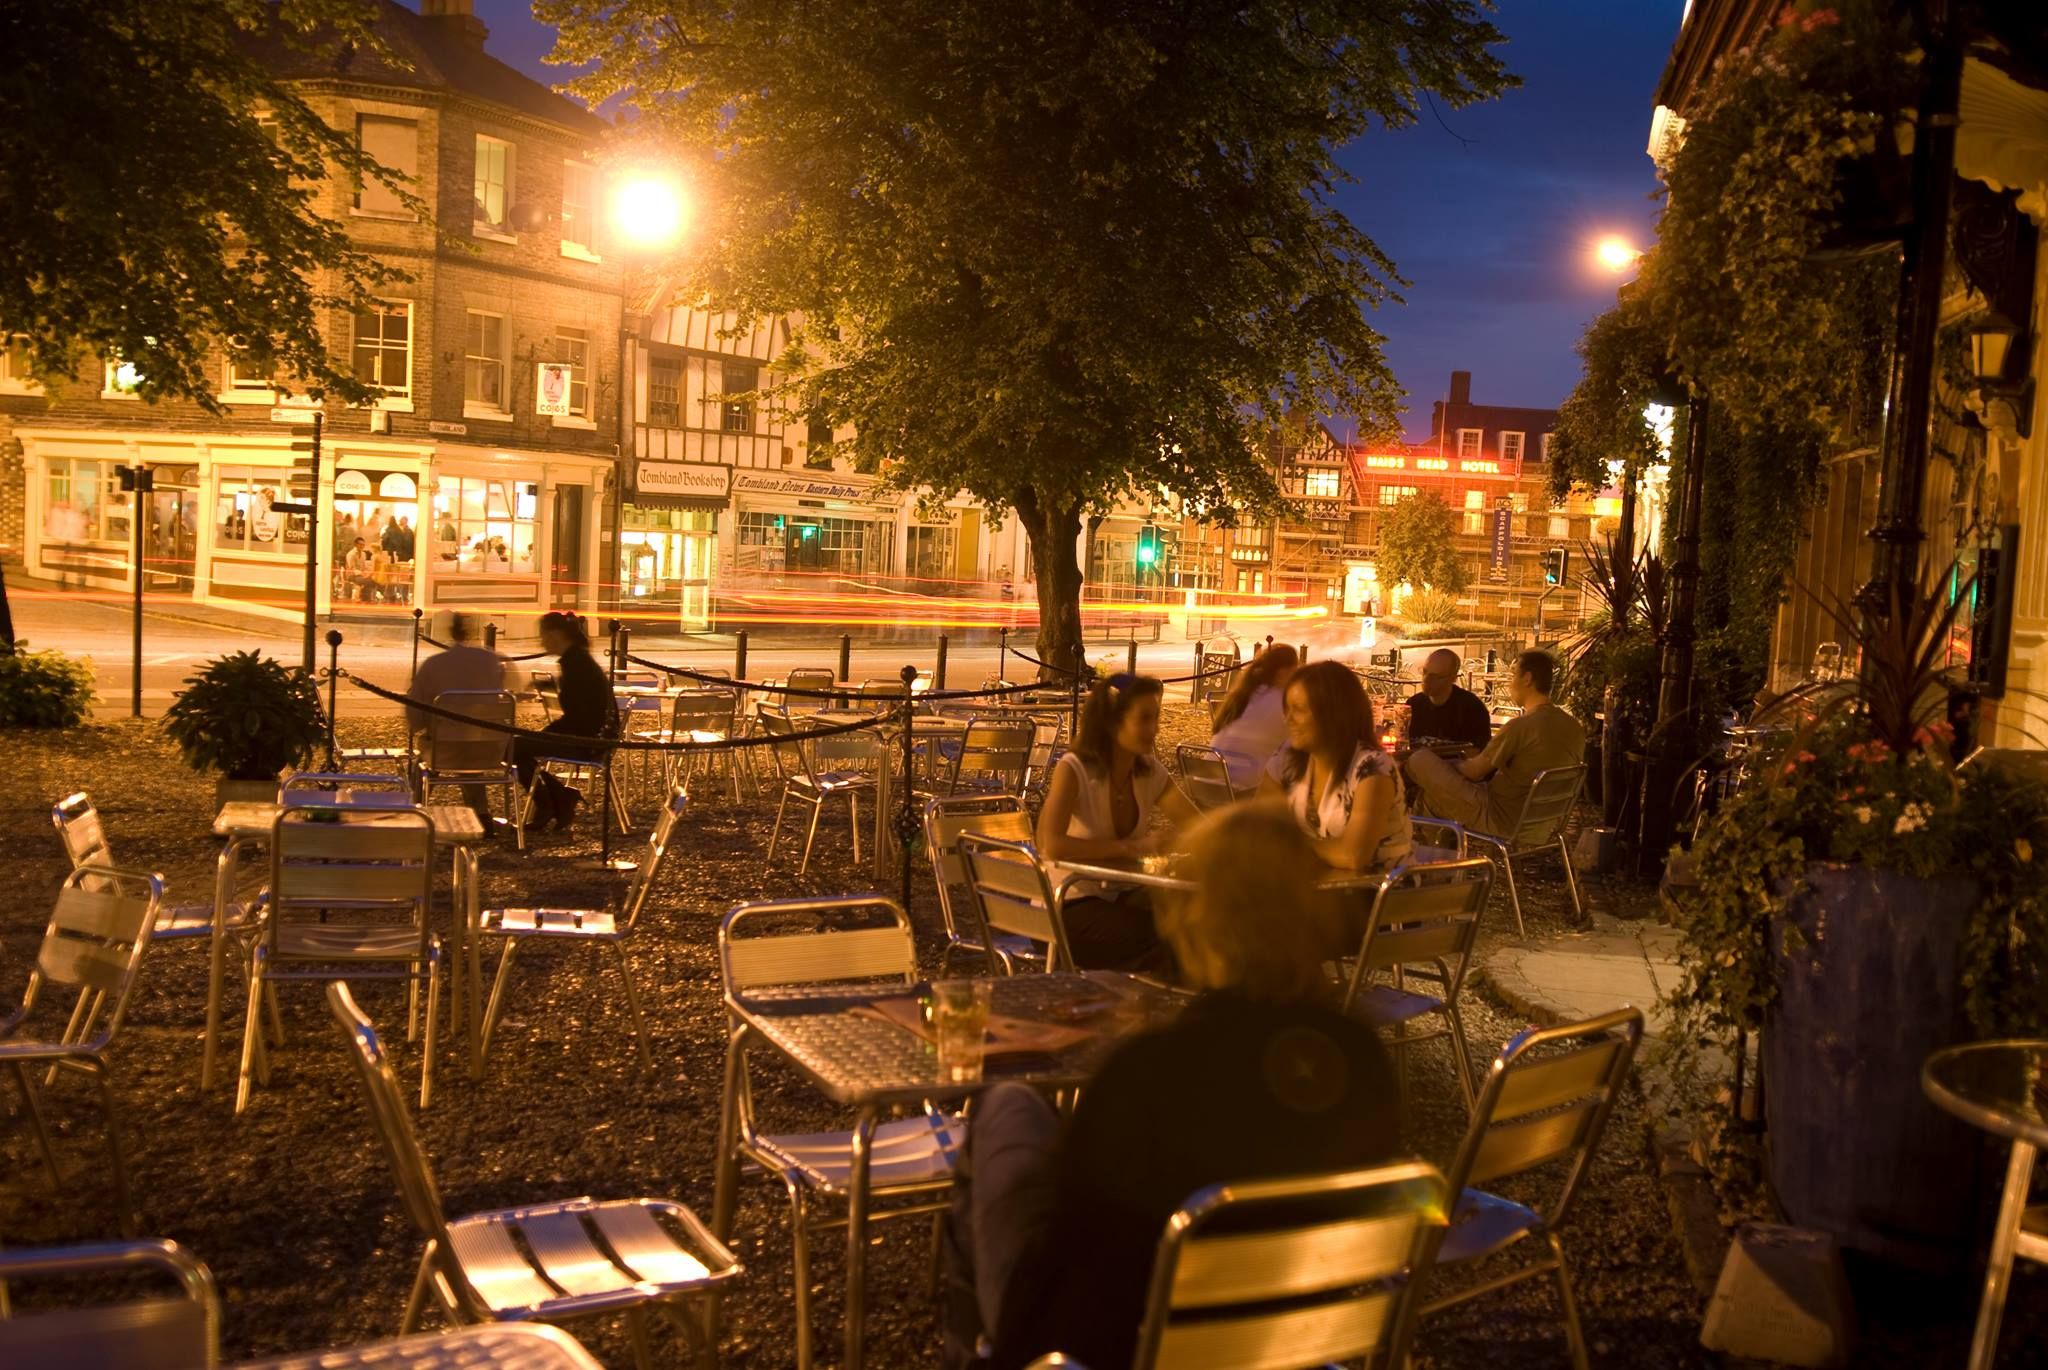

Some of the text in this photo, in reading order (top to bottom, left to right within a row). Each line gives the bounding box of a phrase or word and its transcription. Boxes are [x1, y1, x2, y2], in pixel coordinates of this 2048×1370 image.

[1367, 456, 1500, 473] MAIDS HEAD HOTEL
[640, 468, 726, 489] Tombland Bookshop
[738, 476, 805, 492] Tombland News
[806, 483, 861, 497] Eastern Daily Press
